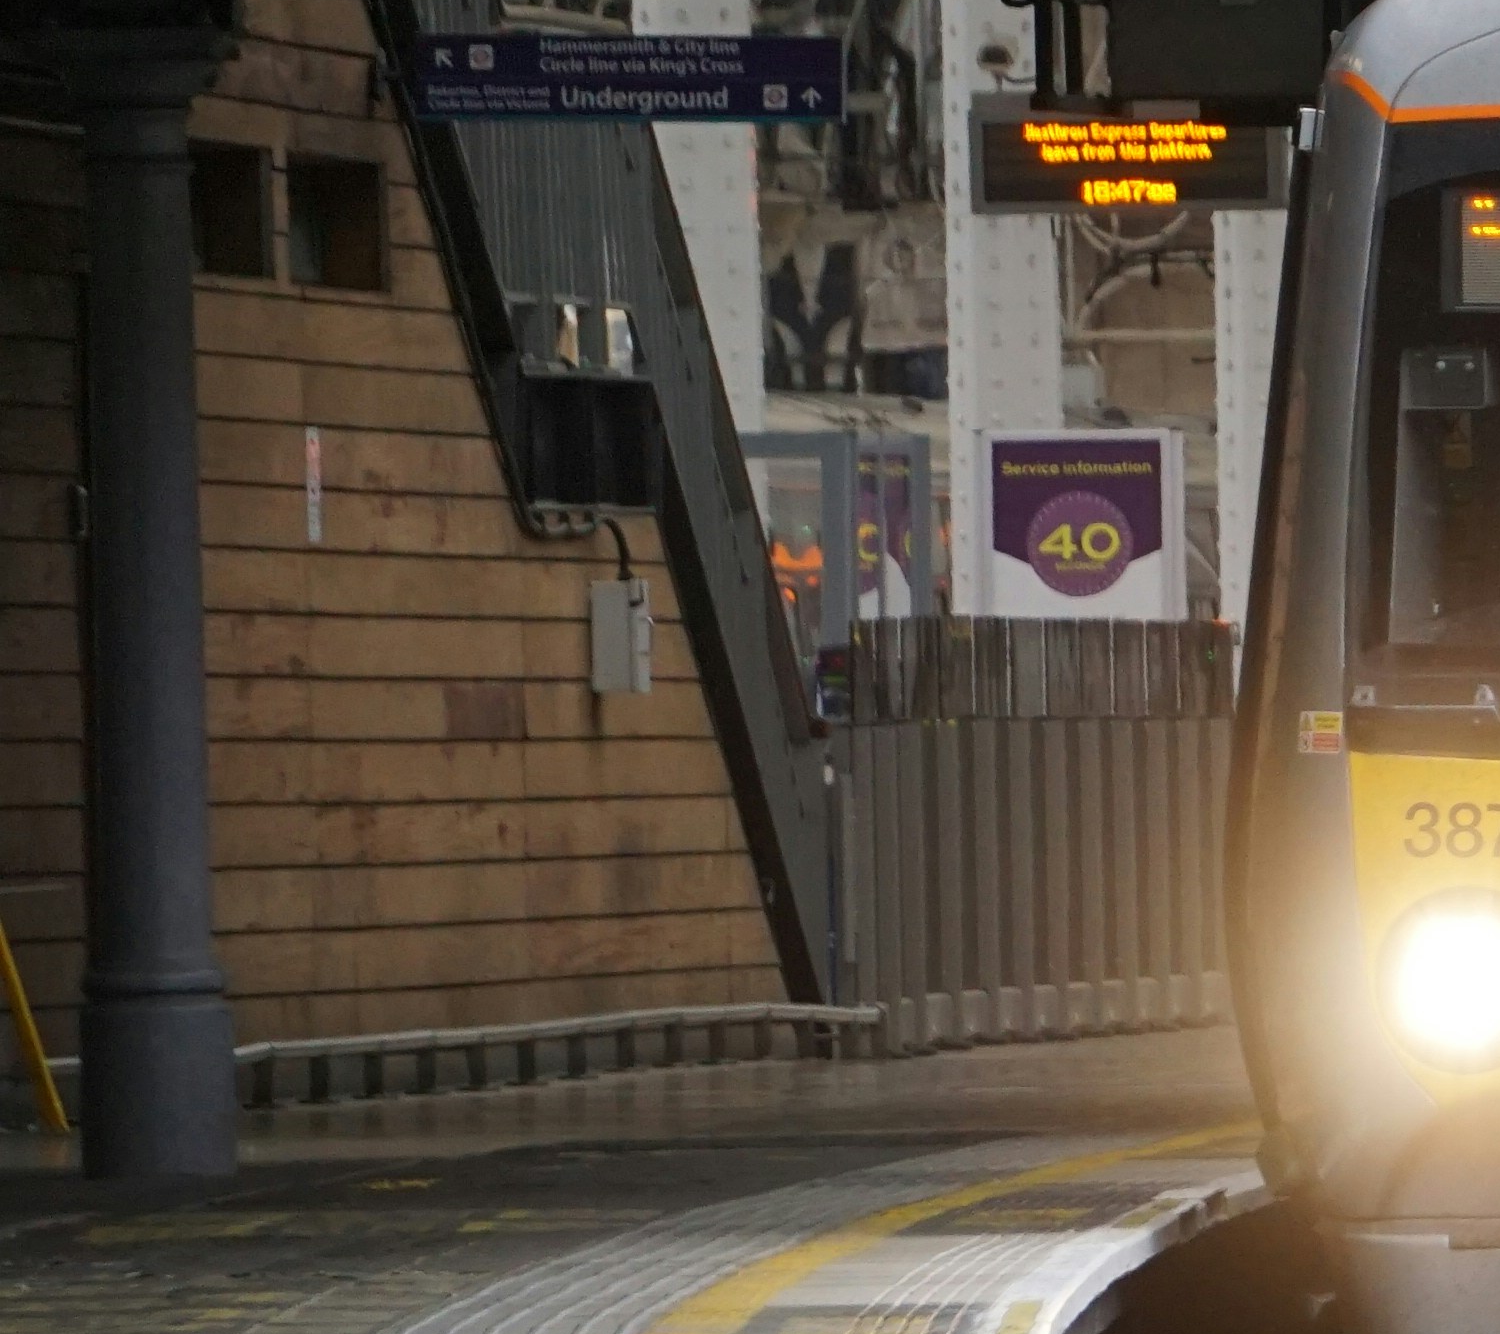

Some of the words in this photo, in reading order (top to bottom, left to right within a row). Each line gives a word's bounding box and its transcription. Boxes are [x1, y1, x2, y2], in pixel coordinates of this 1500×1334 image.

[540, 38, 655, 54] Hammersmith
[659, 39, 671, 54] &
[675, 38, 705, 56] City
[709, 38, 741, 54] line
[539, 57, 585, 72] Circle
[589, 57, 620, 73] line
[622, 58, 647, 73] via
[650, 57, 699, 77] King's
[701, 57, 746, 74] Cross
[560, 85, 730, 116] Underground
[1090, 122, 1146, 144] Express
[1041, 143, 1080, 162] leave
[1081, 142, 1116, 161] from
[1119, 141, 1146, 160] this
[1149, 141, 1213, 163] platform
[1002, 461, 1060, 476] Service
[1063, 460, 1153, 475] information
[1038, 522, 1121, 561] 40
